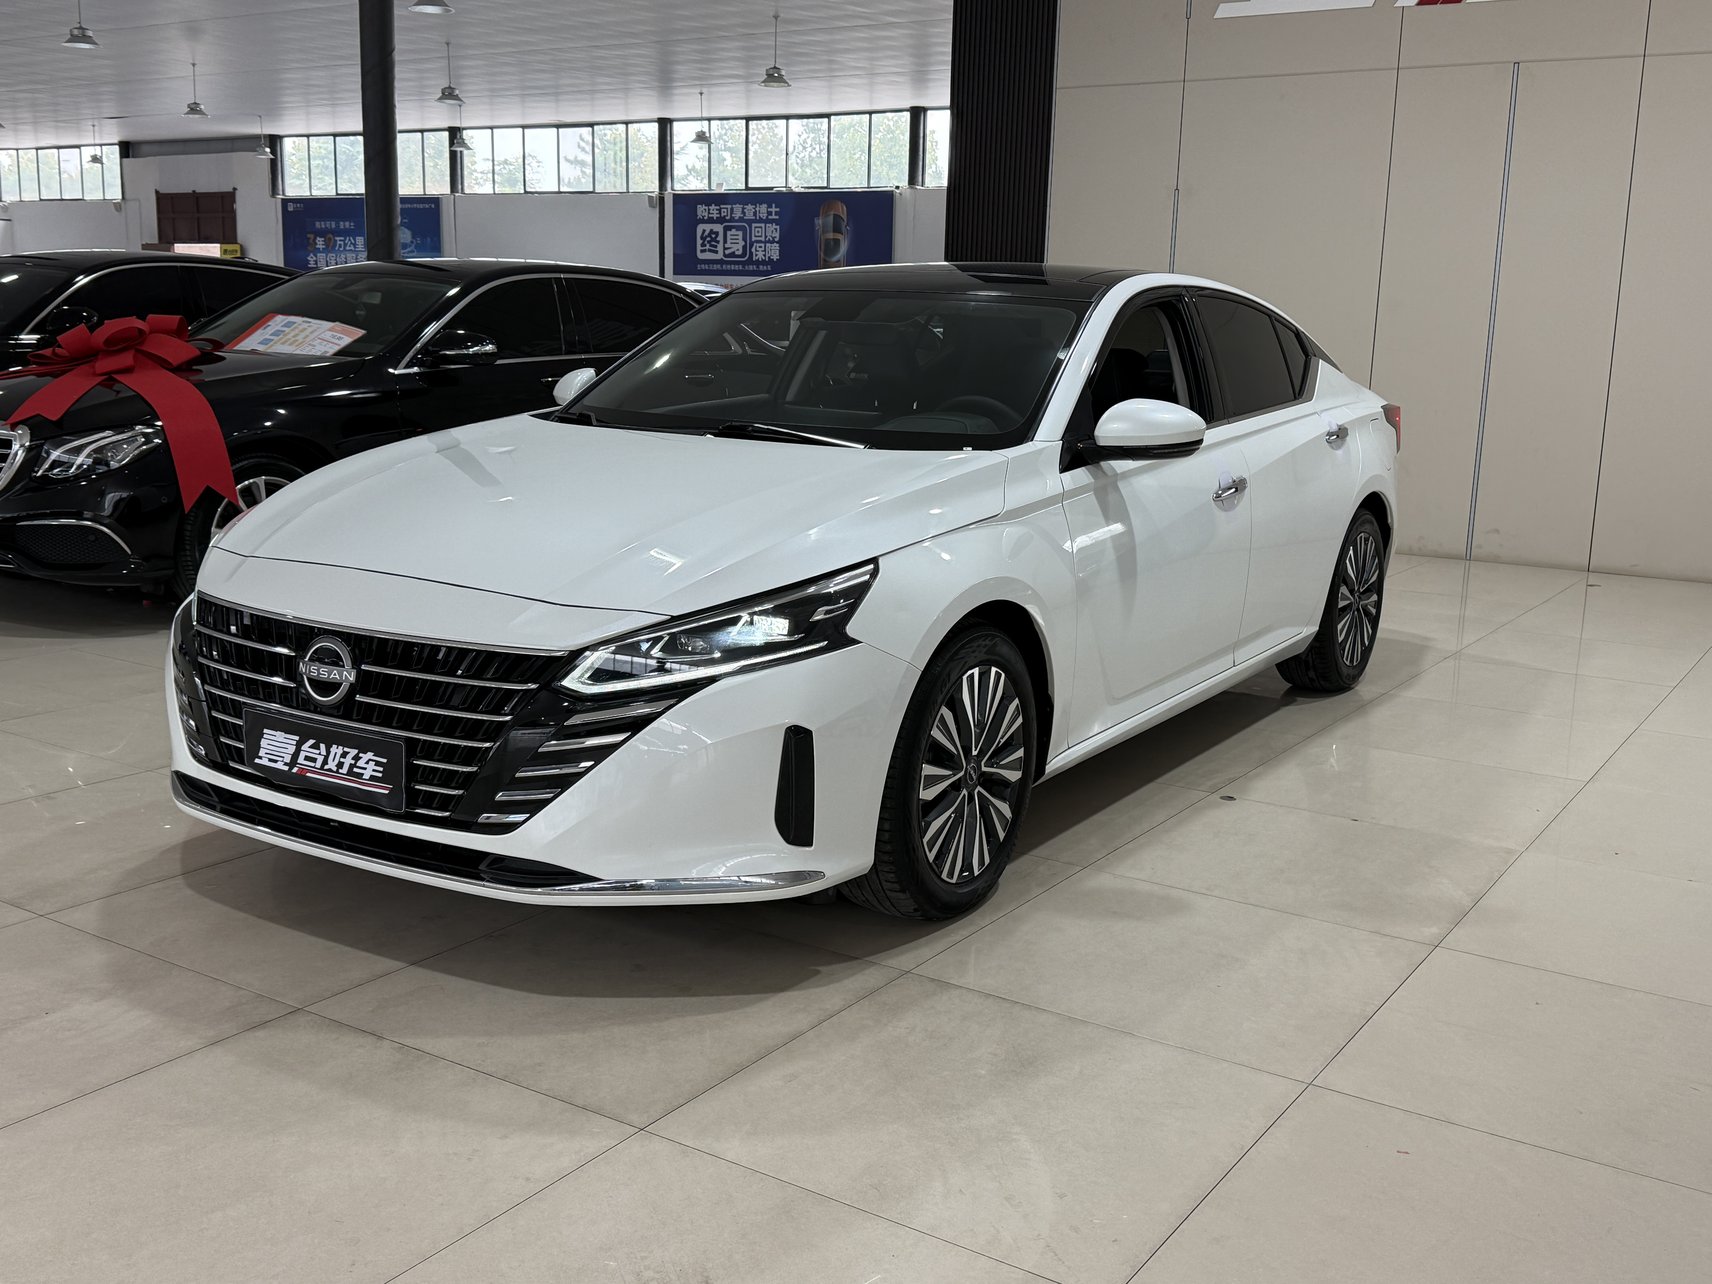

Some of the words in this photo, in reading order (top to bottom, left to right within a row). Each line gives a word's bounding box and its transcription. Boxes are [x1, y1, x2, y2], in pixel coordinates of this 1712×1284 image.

[696, 203, 780, 220] 购车可享查博士
[699, 228, 745, 256] 终身
[751, 222, 780, 242] 回购
[751, 242, 780, 262] 保障
[299, 661, 355, 682] NISSAN
[254, 728, 388, 780] 壹台好车
